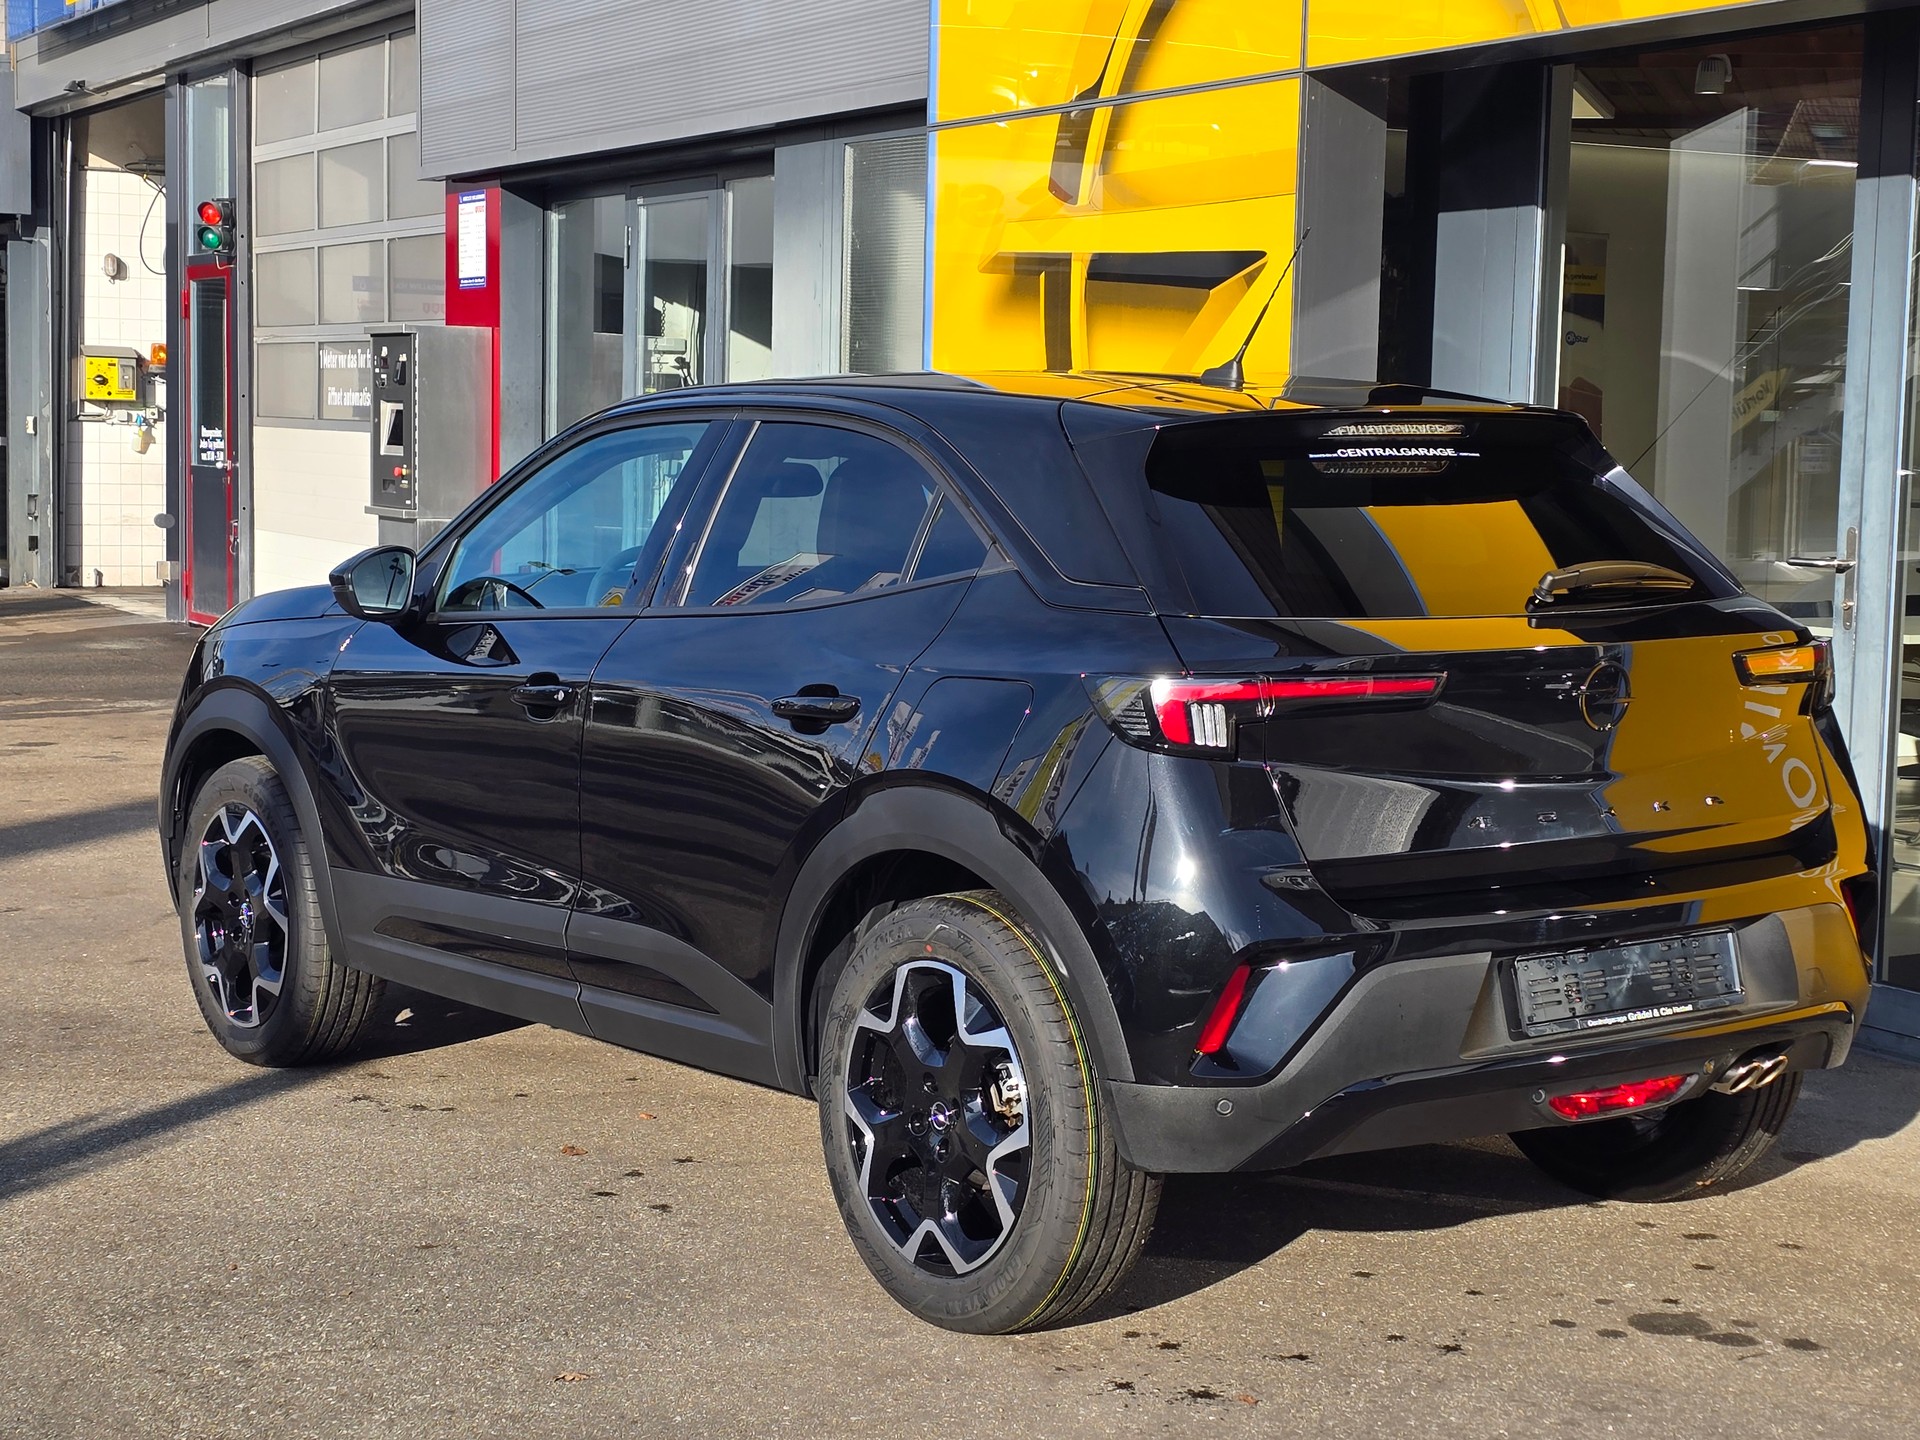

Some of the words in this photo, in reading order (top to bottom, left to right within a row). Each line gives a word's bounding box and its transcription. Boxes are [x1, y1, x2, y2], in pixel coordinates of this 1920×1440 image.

[323, 349, 337, 368] Meter
[338, 354, 347, 368] vor
[348, 349, 357, 368] das
[357, 348, 366, 368] Tor
[328, 387, 342, 405] öffnet
[1336, 447, 1458, 457] CENTRALGARAGE
[1628, 1009, 1653, 1021] Grädel
[1653, 1008, 1660, 1017] &
